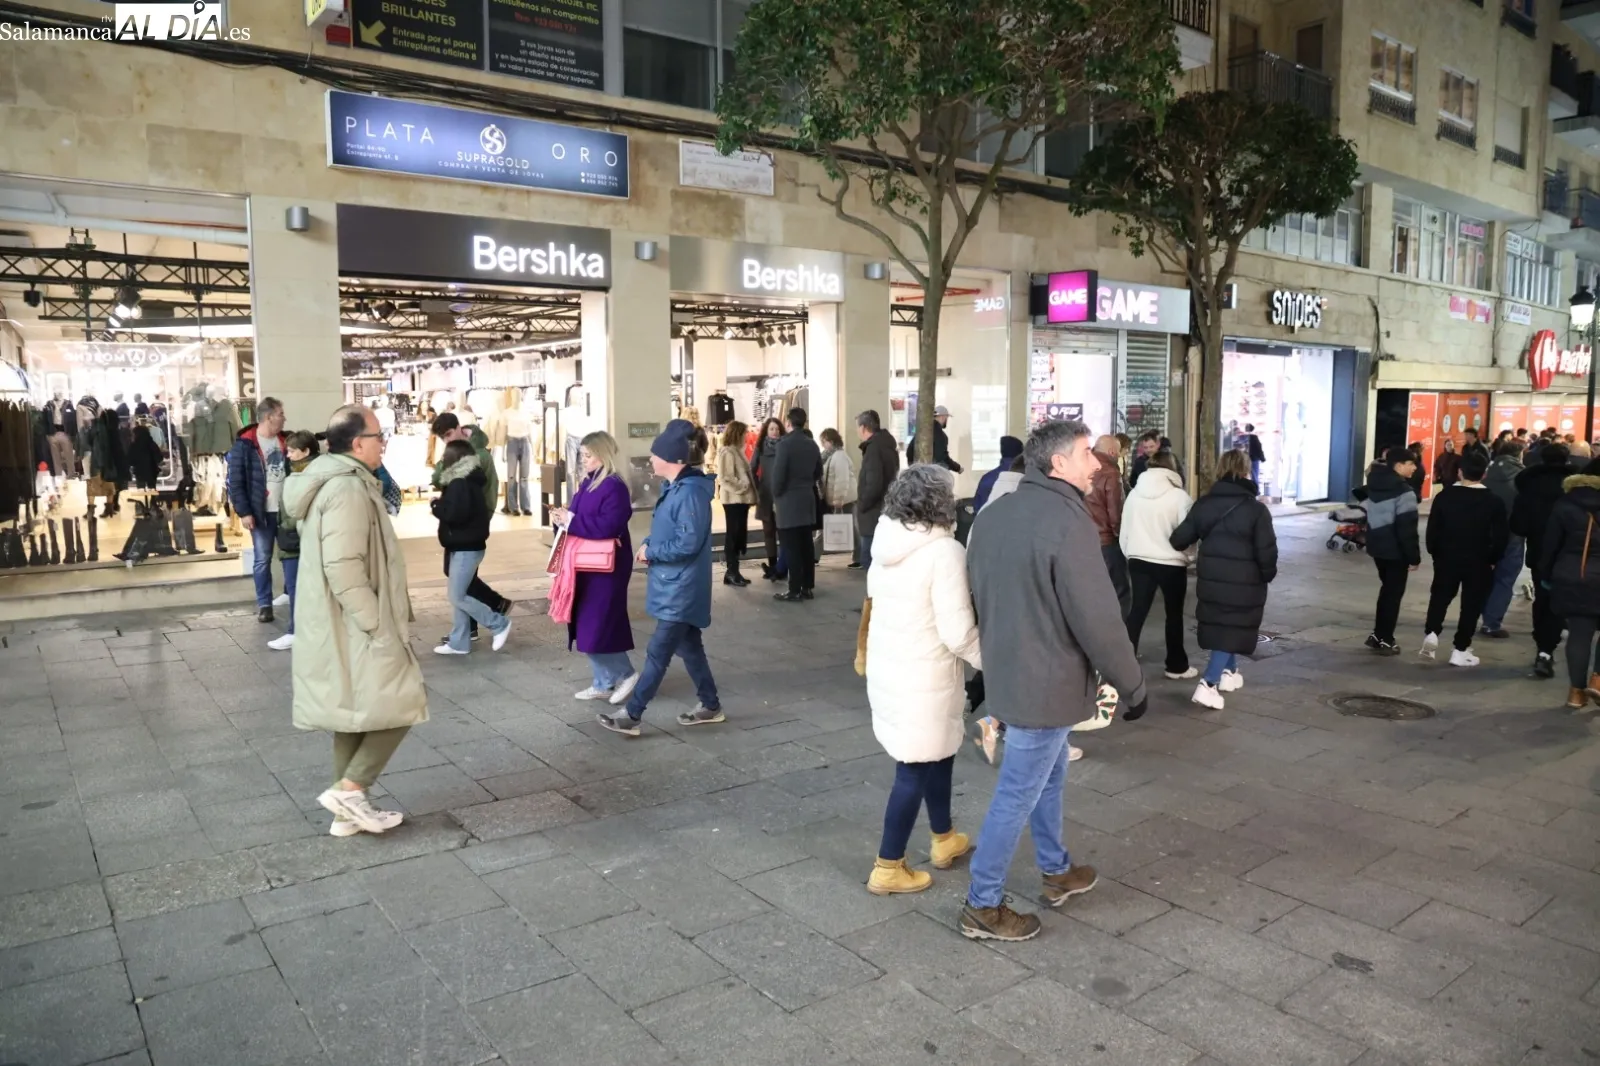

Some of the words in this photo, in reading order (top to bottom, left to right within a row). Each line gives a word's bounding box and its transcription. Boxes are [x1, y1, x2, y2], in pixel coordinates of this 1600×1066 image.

[381, 2, 456, 27] BRILLANTES
[541, 6, 551, 15] sin
[553, 8, 600, 25] compromiso
[392, 26, 425, 41] Entrada
[427, 34, 441, 44] por
[443, 37, 451, 46] el
[453, 39, 476, 51] portal
[392, 37, 441, 54] Entreplanta
[442, 47, 469, 60] oficina
[537, 43, 554, 53] joyas
[550, 55, 577, 65] especial
[524, 66, 545, 76] puede
[556, 71, 570, 81] muy
[345, 116, 435, 145] PLATA
[551, 143, 618, 167] ORO
[438, 160, 470, 169] COMPRA
[481, 166, 506, 174] VENTA
[522, 170, 545, 179] JOYAS
[456, 151, 530, 169] SUPRAGOLD
[473, 235, 605, 279] Bershka
[743, 258, 840, 296] Bershka
[1049, 288, 1088, 306] GAME
[1096, 286, 1159, 325] GAME
[1272, 289, 1322, 334] snipes
